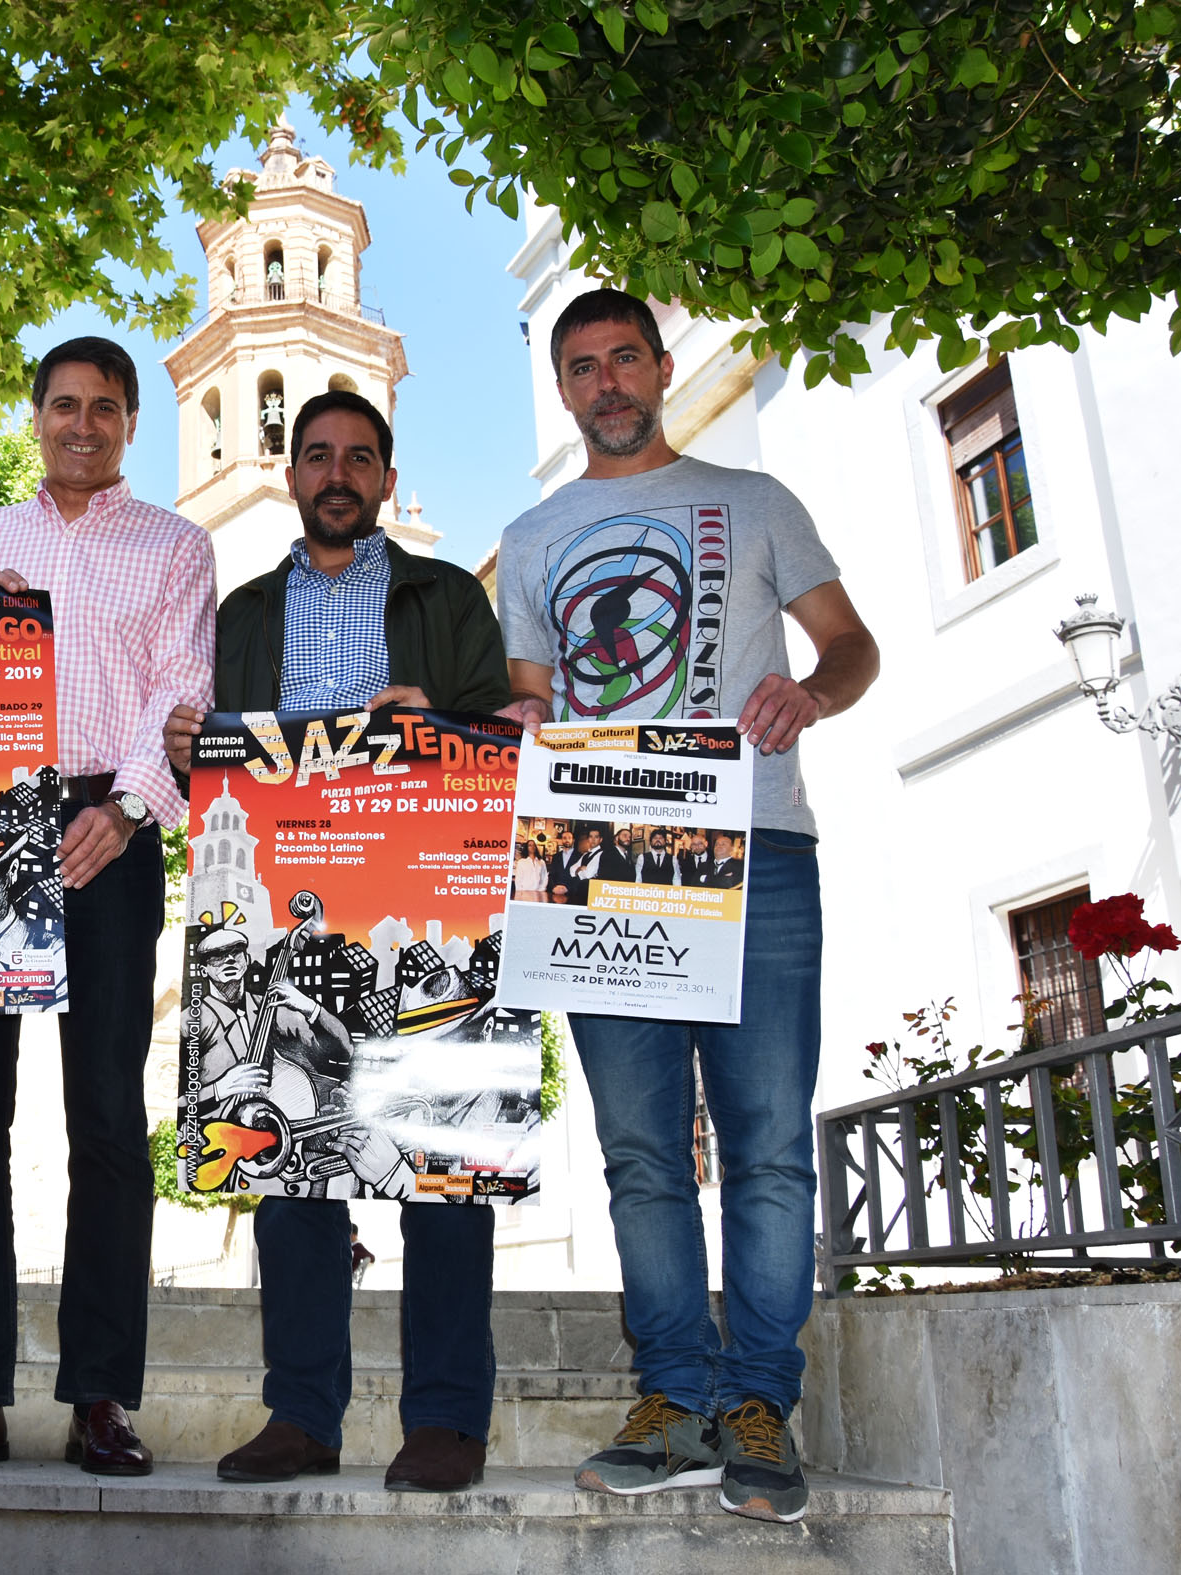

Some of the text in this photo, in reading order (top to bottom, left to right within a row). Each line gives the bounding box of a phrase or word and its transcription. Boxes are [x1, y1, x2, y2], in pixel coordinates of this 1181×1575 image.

[2, 595, 40, 609] EDICIÓN
[4, 666, 43, 680] 2019
[31, 702, 43, 710] 29
[469, 723, 523, 736] IX EDICIÓN
[592, 728, 634, 737] Cultural
[16, 732, 44, 741] Band
[199, 736, 244, 746] ENTRADA
[645, 730, 734, 752] JAZZ TE DIGO
[12, 742, 44, 753] Swing
[198, 748, 246, 758] GRATUITA
[241, 711, 520, 787] JAZZ TE DIGO
[443, 773, 516, 792] festiva
[321, 780, 428, 799] PLAZA MAYOR BAZA
[329, 797, 516, 814] 28 Y 29 DE JUNIO 201
[578, 802, 692, 819] SKIN TO SKIN TOUR2019
[276, 819, 332, 829] VIERNES 28
[275, 831, 386, 841] Q & The Moonstones
[274, 843, 364, 853] Pacombo Latino
[463, 838, 508, 849] SÁBADO
[274, 855, 366, 866] Ensemble Jazzyc
[418, 851, 510, 864] Santiago Campi
[446, 874, 492, 884] Priscilla
[434, 886, 488, 896] La Causa
[602, 883, 724, 904] Presentación del Festival
[591, 897, 686, 915] JAZZ TE DIGO 2019
[574, 914, 669, 942] SALA
[551, 937, 690, 966] MAMEY
[596, 964, 640, 976] BAZA
[523, 970, 568, 983] VIERNES,
[572, 975, 586, 983] 24
[589, 976, 604, 985] DE
[607, 979, 642, 988] MAYO
[644, 981, 668, 990] 2019
[187, 983, 202, 1182] www.jazztedigofestival.com
